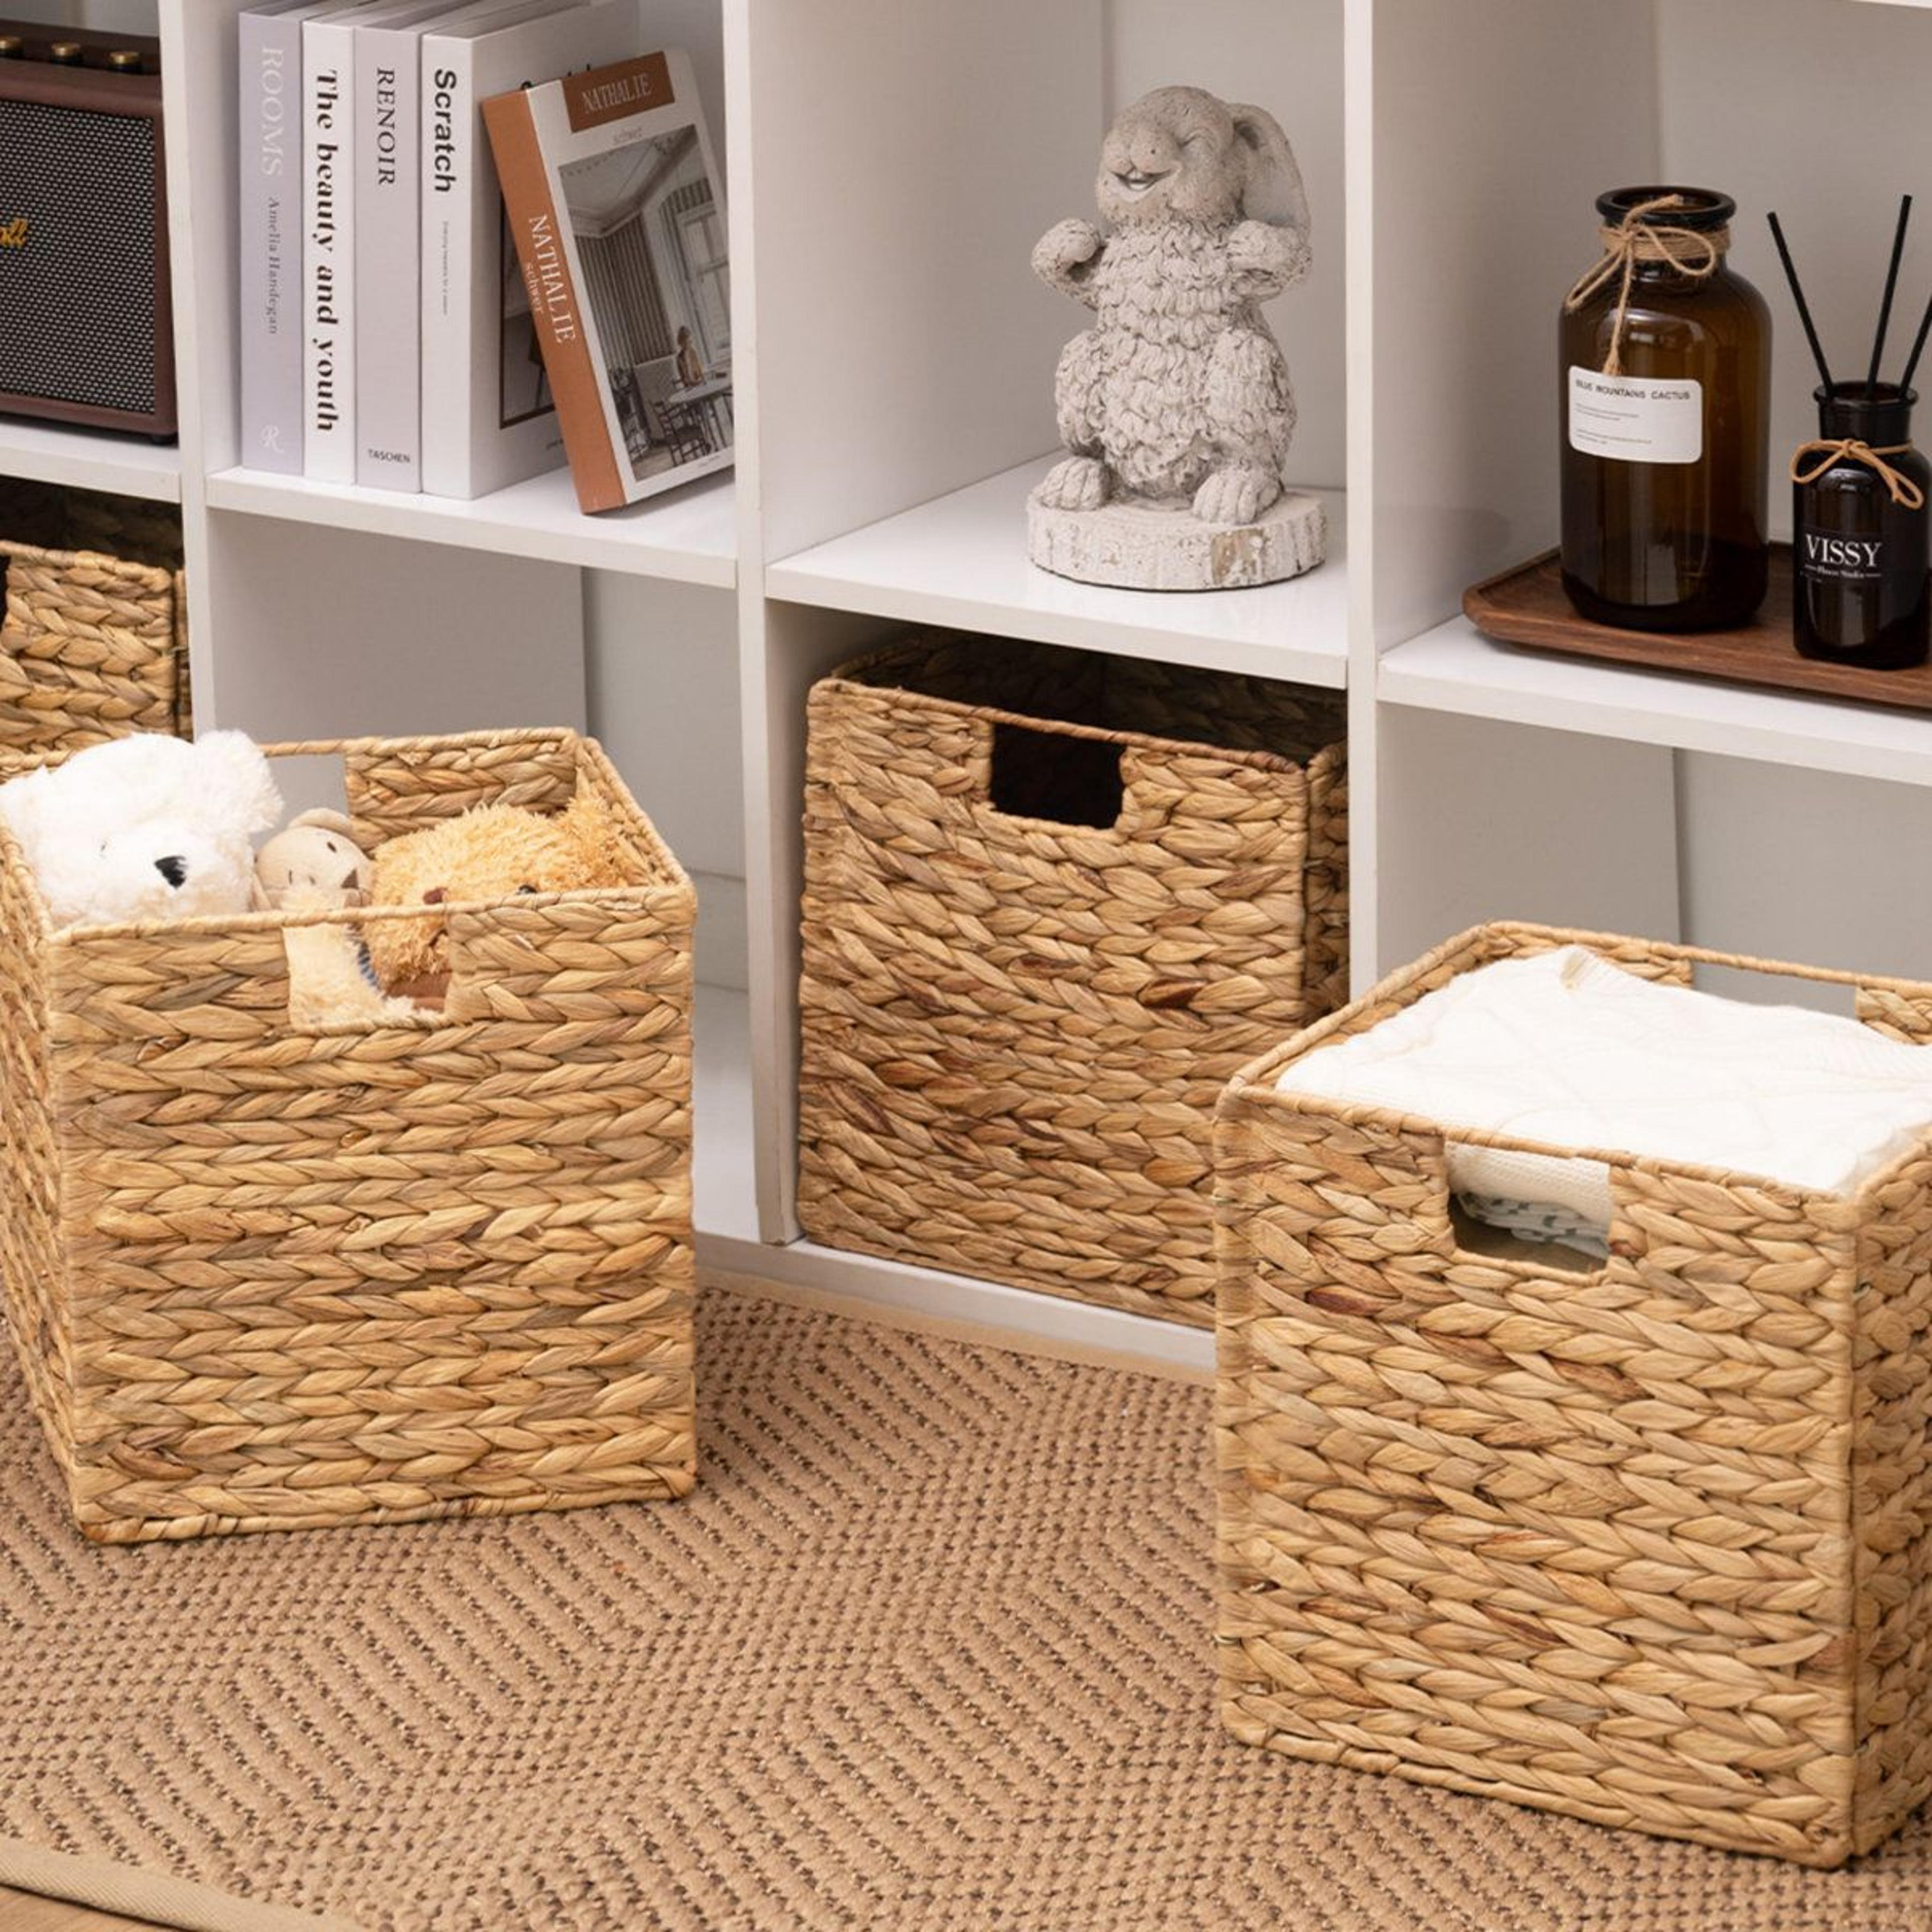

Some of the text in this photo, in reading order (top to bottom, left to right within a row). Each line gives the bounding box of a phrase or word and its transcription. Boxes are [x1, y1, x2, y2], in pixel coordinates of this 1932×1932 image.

[261, 48, 284, 177] ROOMS
[376, 67, 395, 186] RENOIR
[434, 68, 457, 192] Scratch
[582, 73, 653, 114] NATHALIE
[312, 68, 339, 431] The beauty and youth
[529, 214, 576, 344] NATHALIE
[1651, 390, 1691, 400] CACTUS
[368, 448, 411, 463] TASCHEN
[1806, 533, 1882, 567] VISSY
